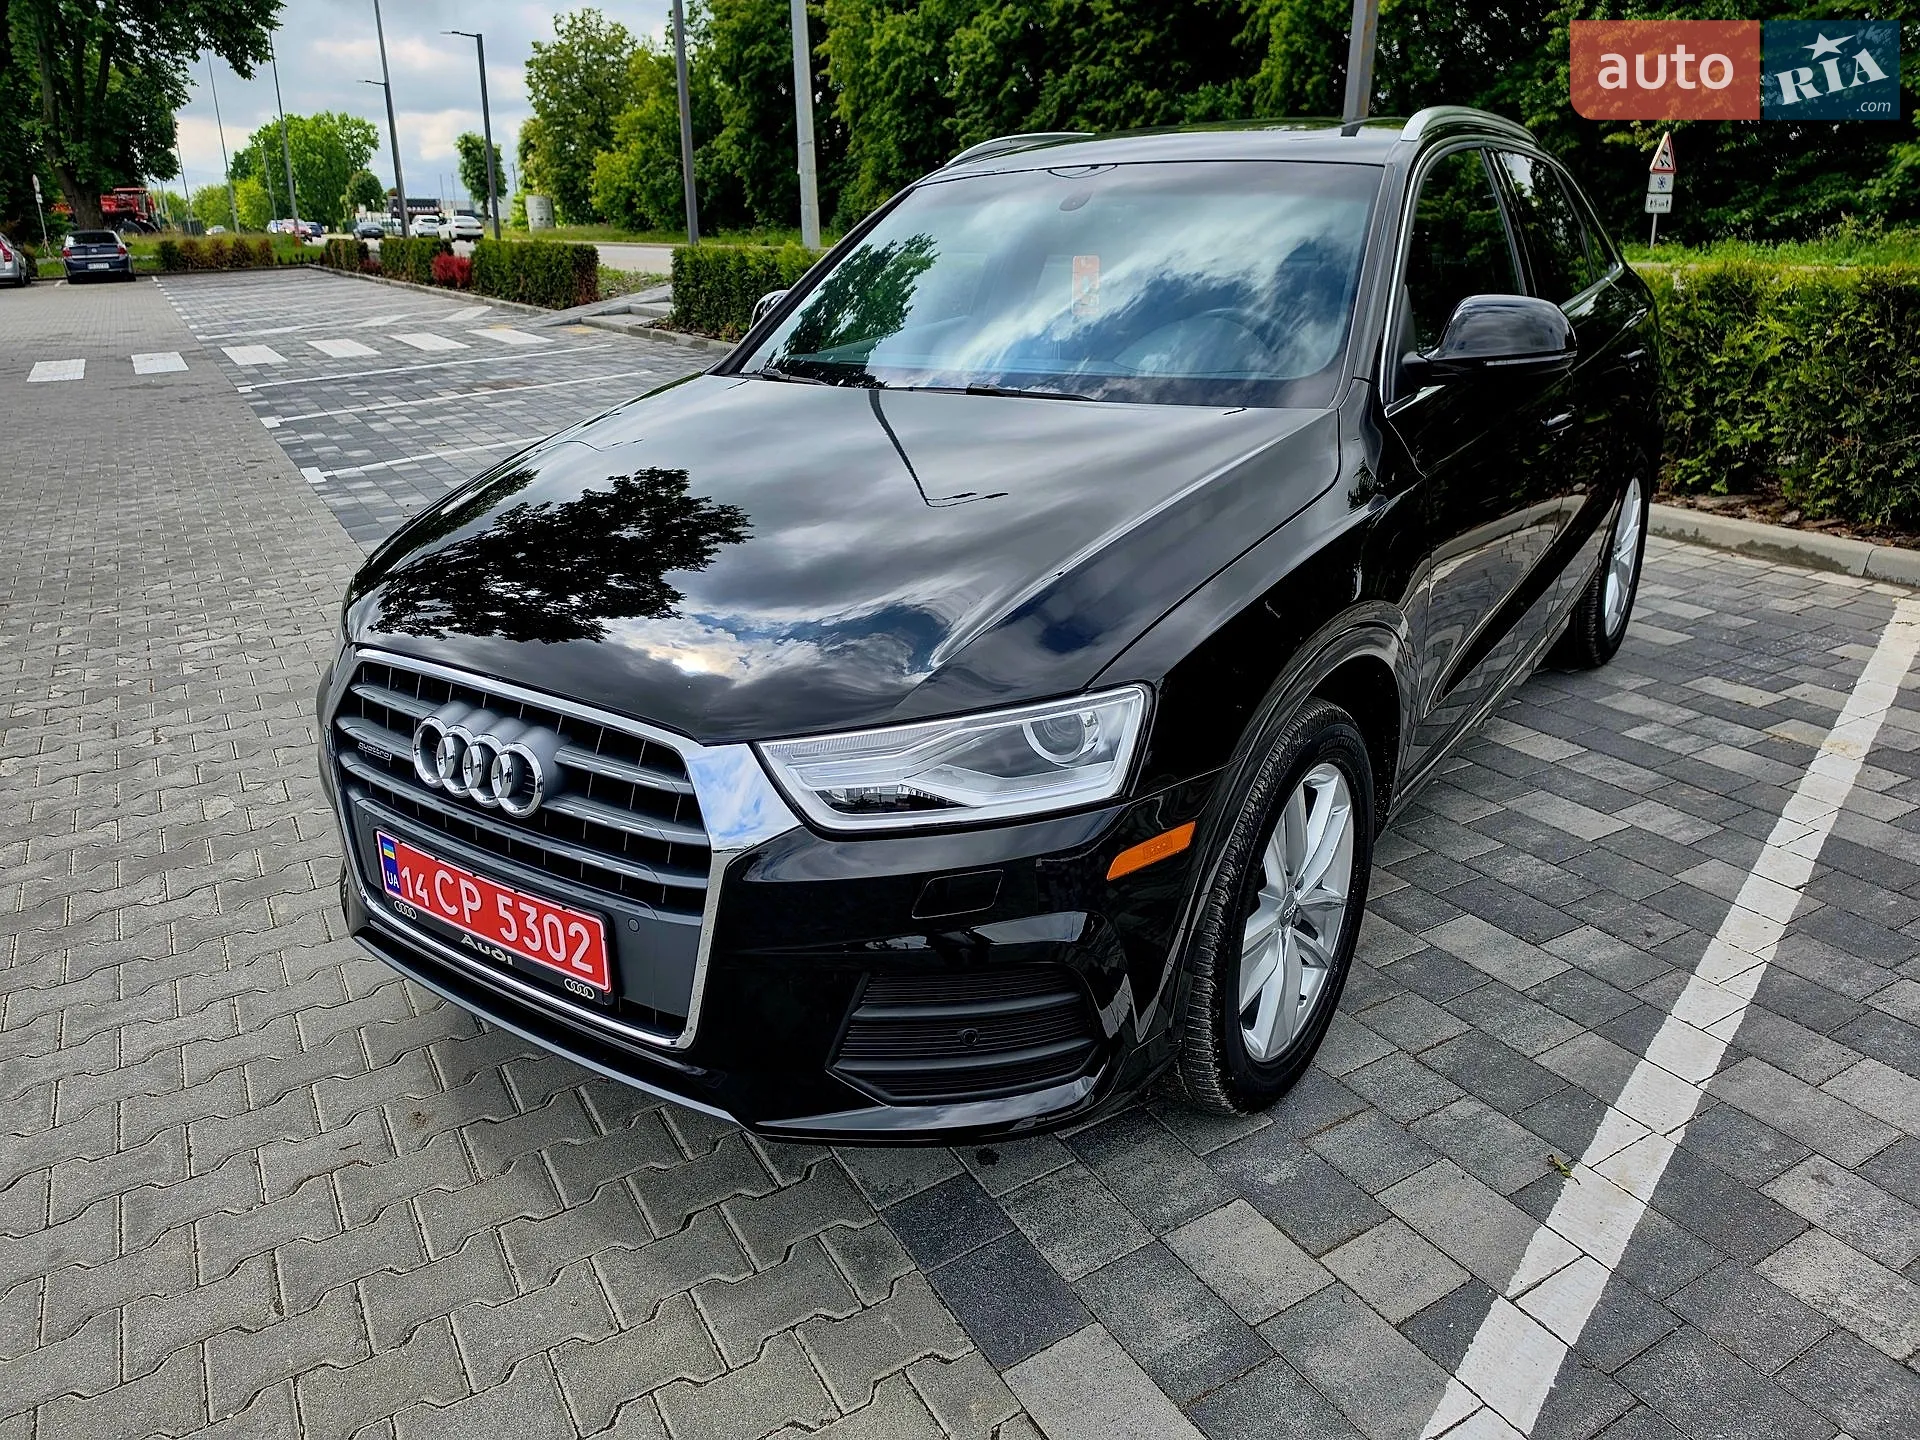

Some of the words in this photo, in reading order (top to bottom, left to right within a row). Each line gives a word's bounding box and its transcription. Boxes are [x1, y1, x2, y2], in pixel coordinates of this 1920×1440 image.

[358, 741, 391, 760] quattro
[387, 870, 400, 889] UA
[496, 893, 594, 974] 5302
[460, 934, 515, 966] Audi
